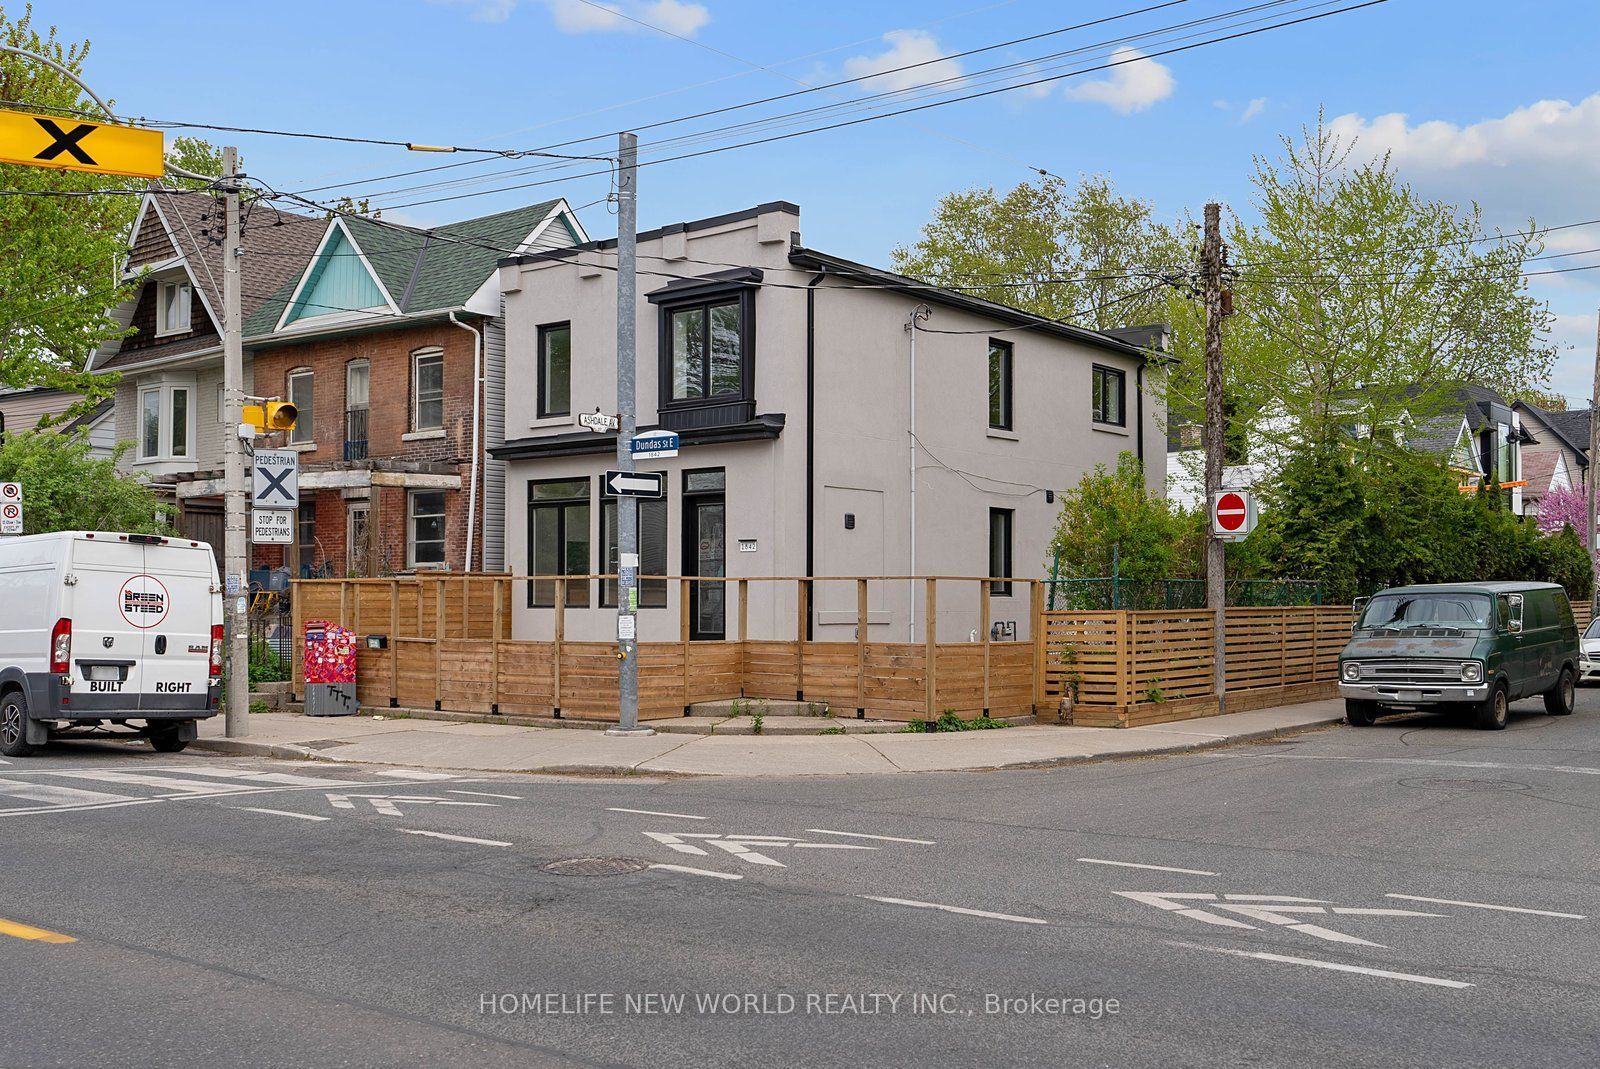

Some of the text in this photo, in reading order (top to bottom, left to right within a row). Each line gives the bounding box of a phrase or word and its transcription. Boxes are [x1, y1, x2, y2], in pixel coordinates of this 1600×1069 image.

[33, 117, 99, 166] X
[584, 416, 608, 426] ASHDALE
[636, 440, 662, 450] Dundas
[670, 438, 674, 447] E
[255, 456, 295, 465] PEDESTRIAN
[259, 516, 287, 524] STOP FOR
[255, 528, 290, 536] PEDESTRIANS
[125, 604, 163, 613] STEED
[90, 682, 191, 692] BUILT RIGHT
